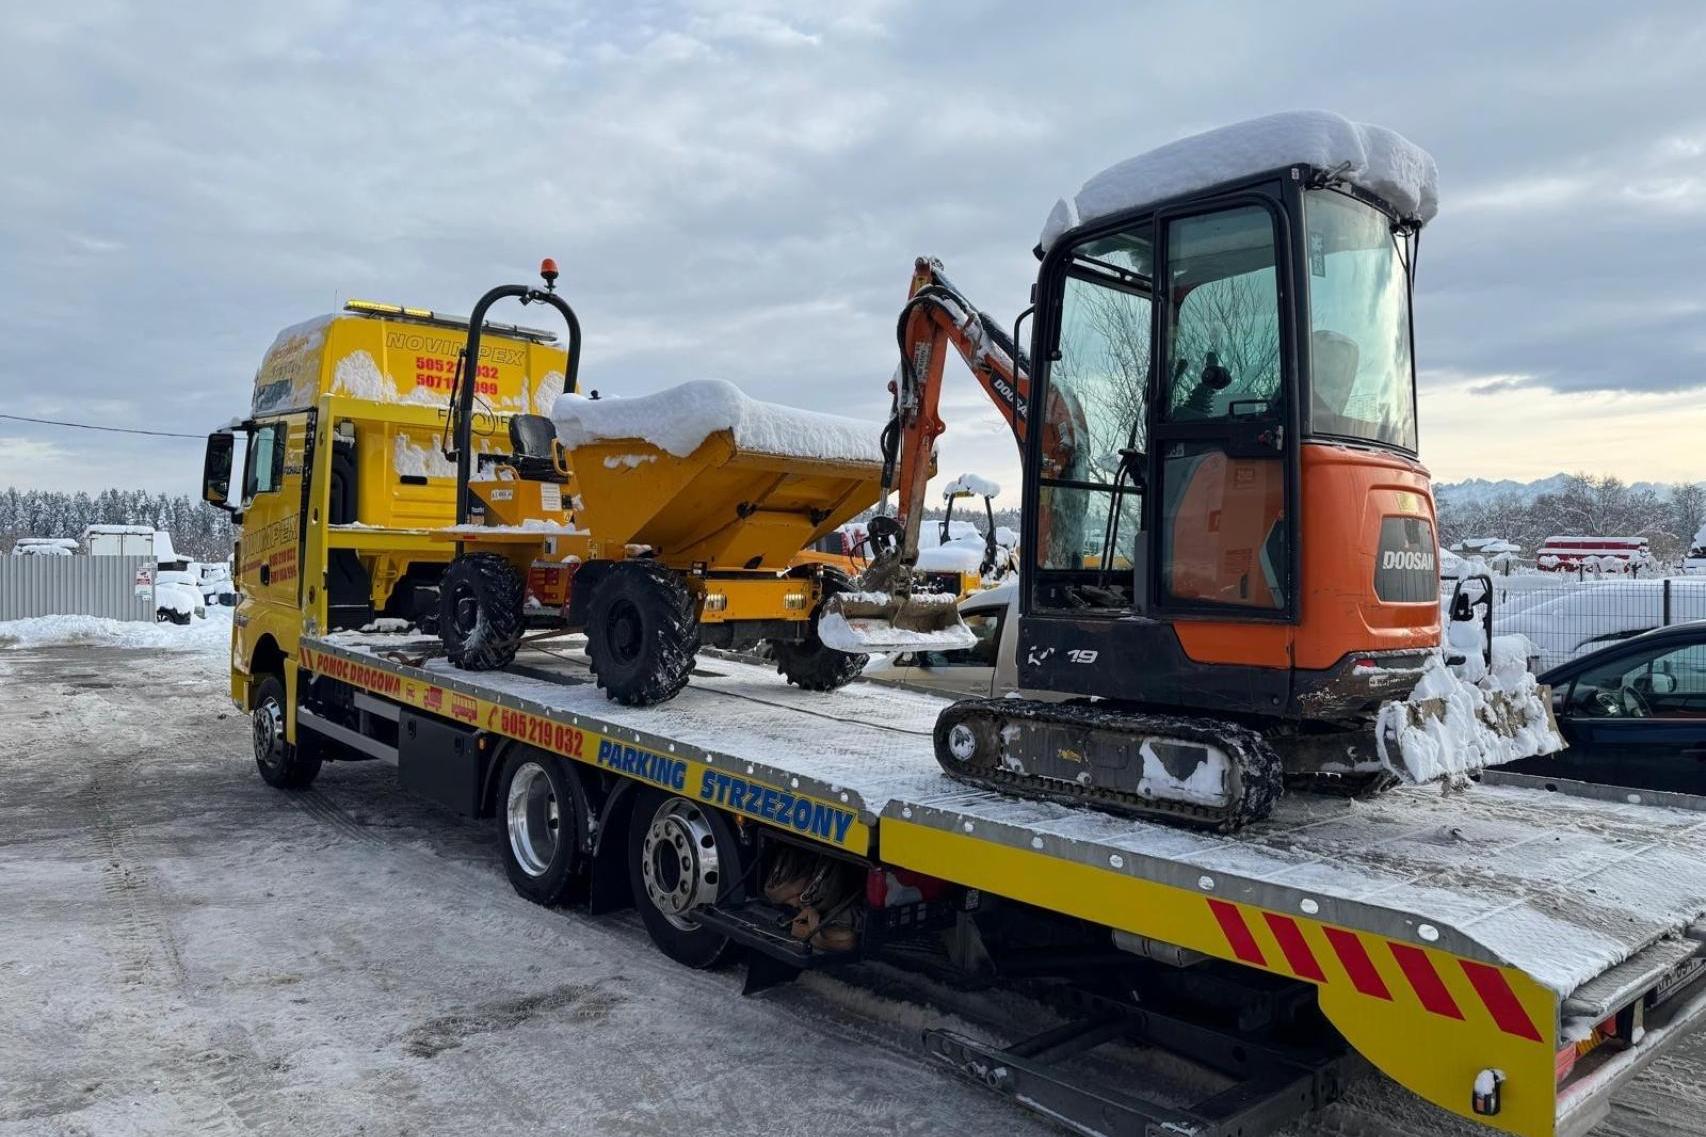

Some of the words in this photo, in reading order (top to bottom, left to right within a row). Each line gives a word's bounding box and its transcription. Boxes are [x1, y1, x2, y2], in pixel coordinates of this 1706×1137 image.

[416, 357, 443, 372] 505
[1382, 550, 1434, 570] DOOSAN
[1067, 649, 1098, 663] 19
[317, 653, 349, 679] POMOC
[350, 663, 401, 693] DROGOWA
[501, 708, 527, 738] 505
[528, 716, 553, 748] 219
[555, 725, 584, 757] 032
[597, 740, 688, 790] PARKING
